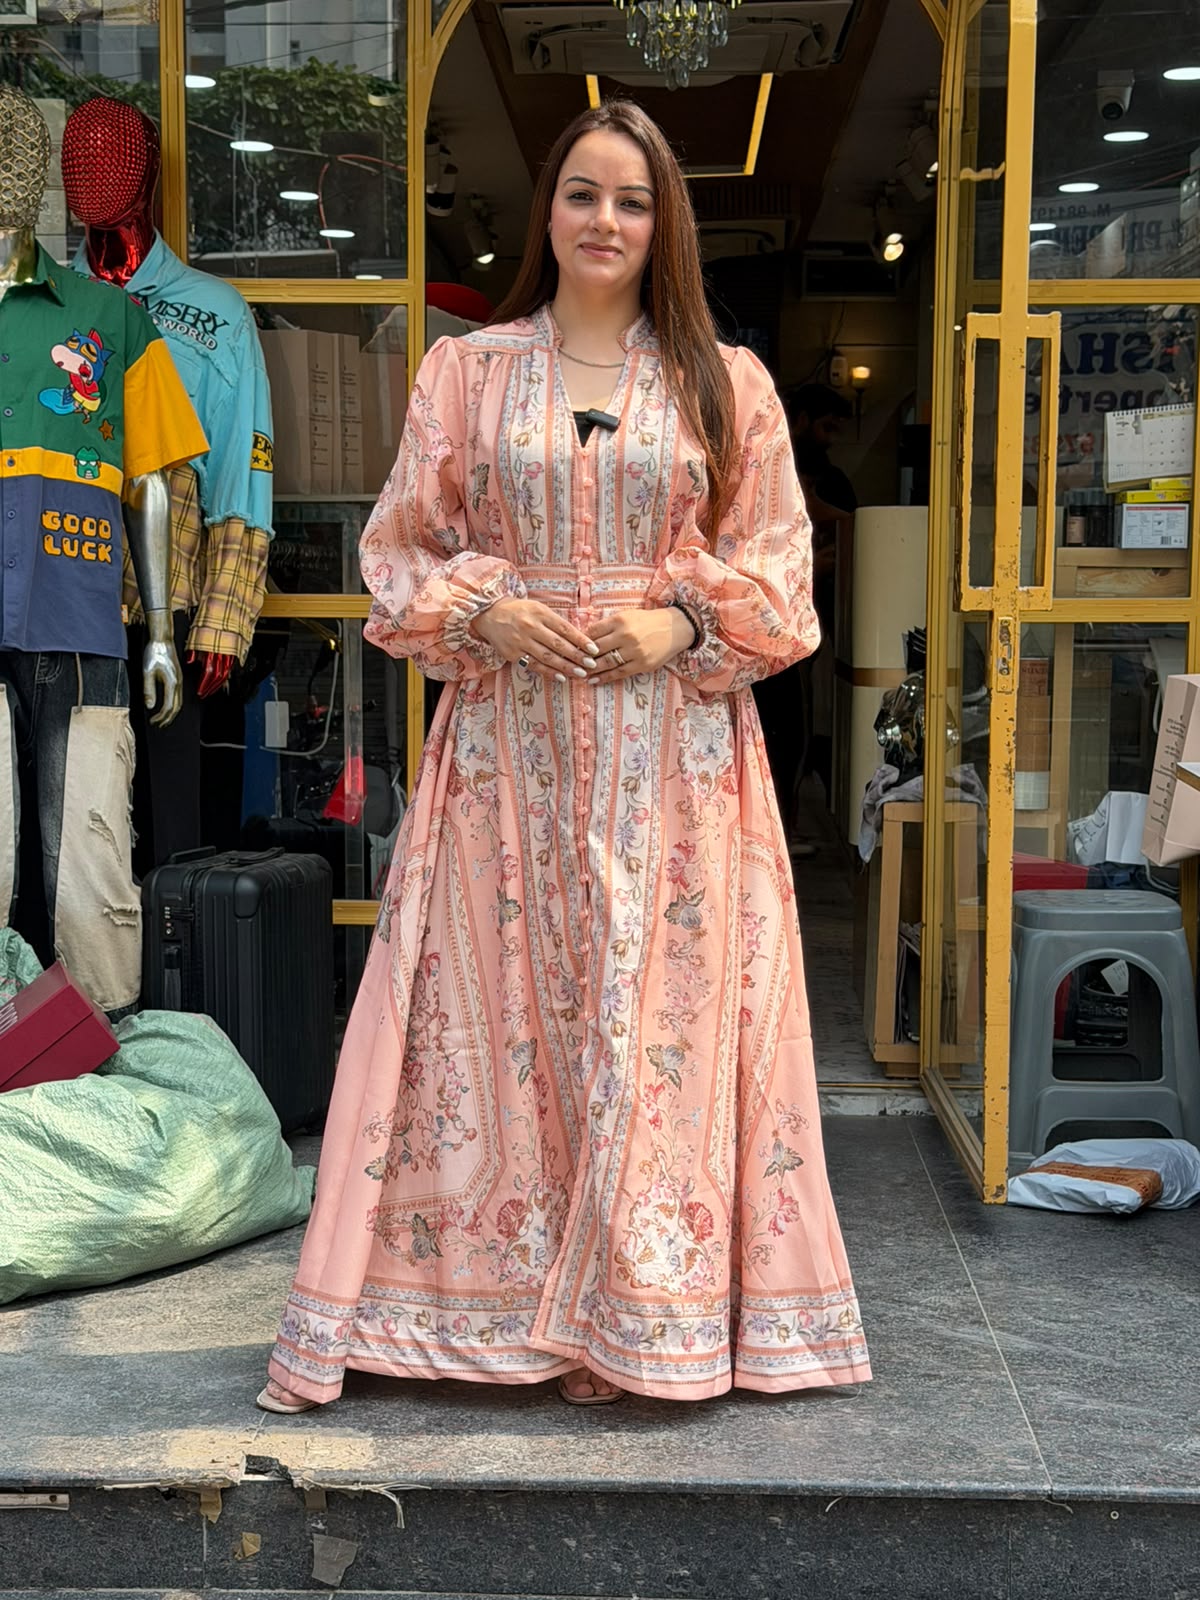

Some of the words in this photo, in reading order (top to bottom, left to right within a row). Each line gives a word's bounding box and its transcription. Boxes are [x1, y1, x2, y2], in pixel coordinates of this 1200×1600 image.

[140, 295, 230, 337] MISERY
[162, 319, 218, 350] WORLD
[41, 509, 113, 540] GOOD
[43, 533, 112, 565] LUCK
